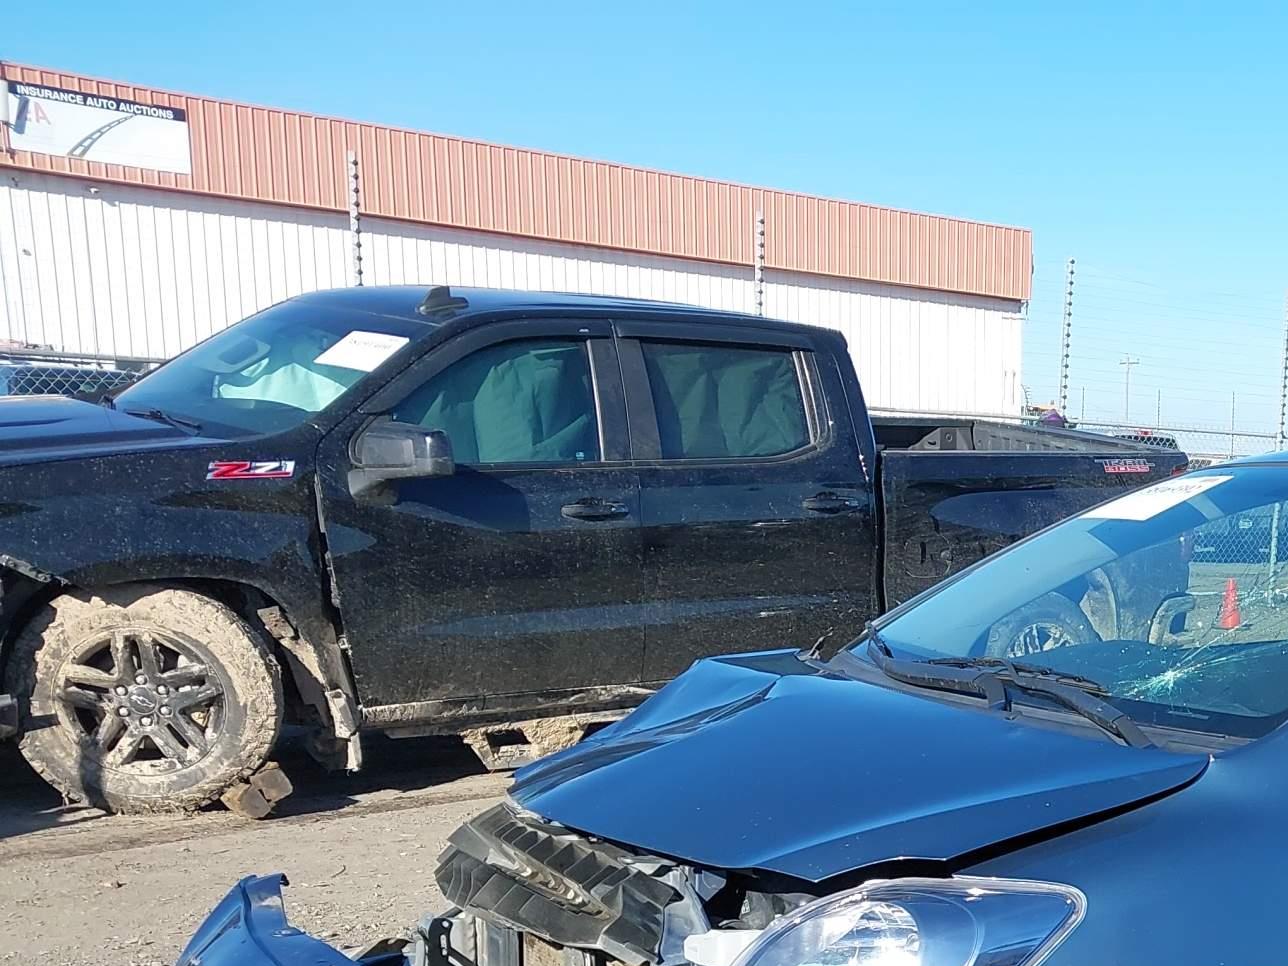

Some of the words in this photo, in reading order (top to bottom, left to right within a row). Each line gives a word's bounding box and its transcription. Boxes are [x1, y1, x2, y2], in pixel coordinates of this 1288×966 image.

[16, 84, 84, 104] INSURANCE
[86, 97, 118, 111] AUTO
[119, 102, 174, 120] AUCTIONS
[206, 460, 296, 480] Z71
[1103, 465, 1151, 474] BOSS
